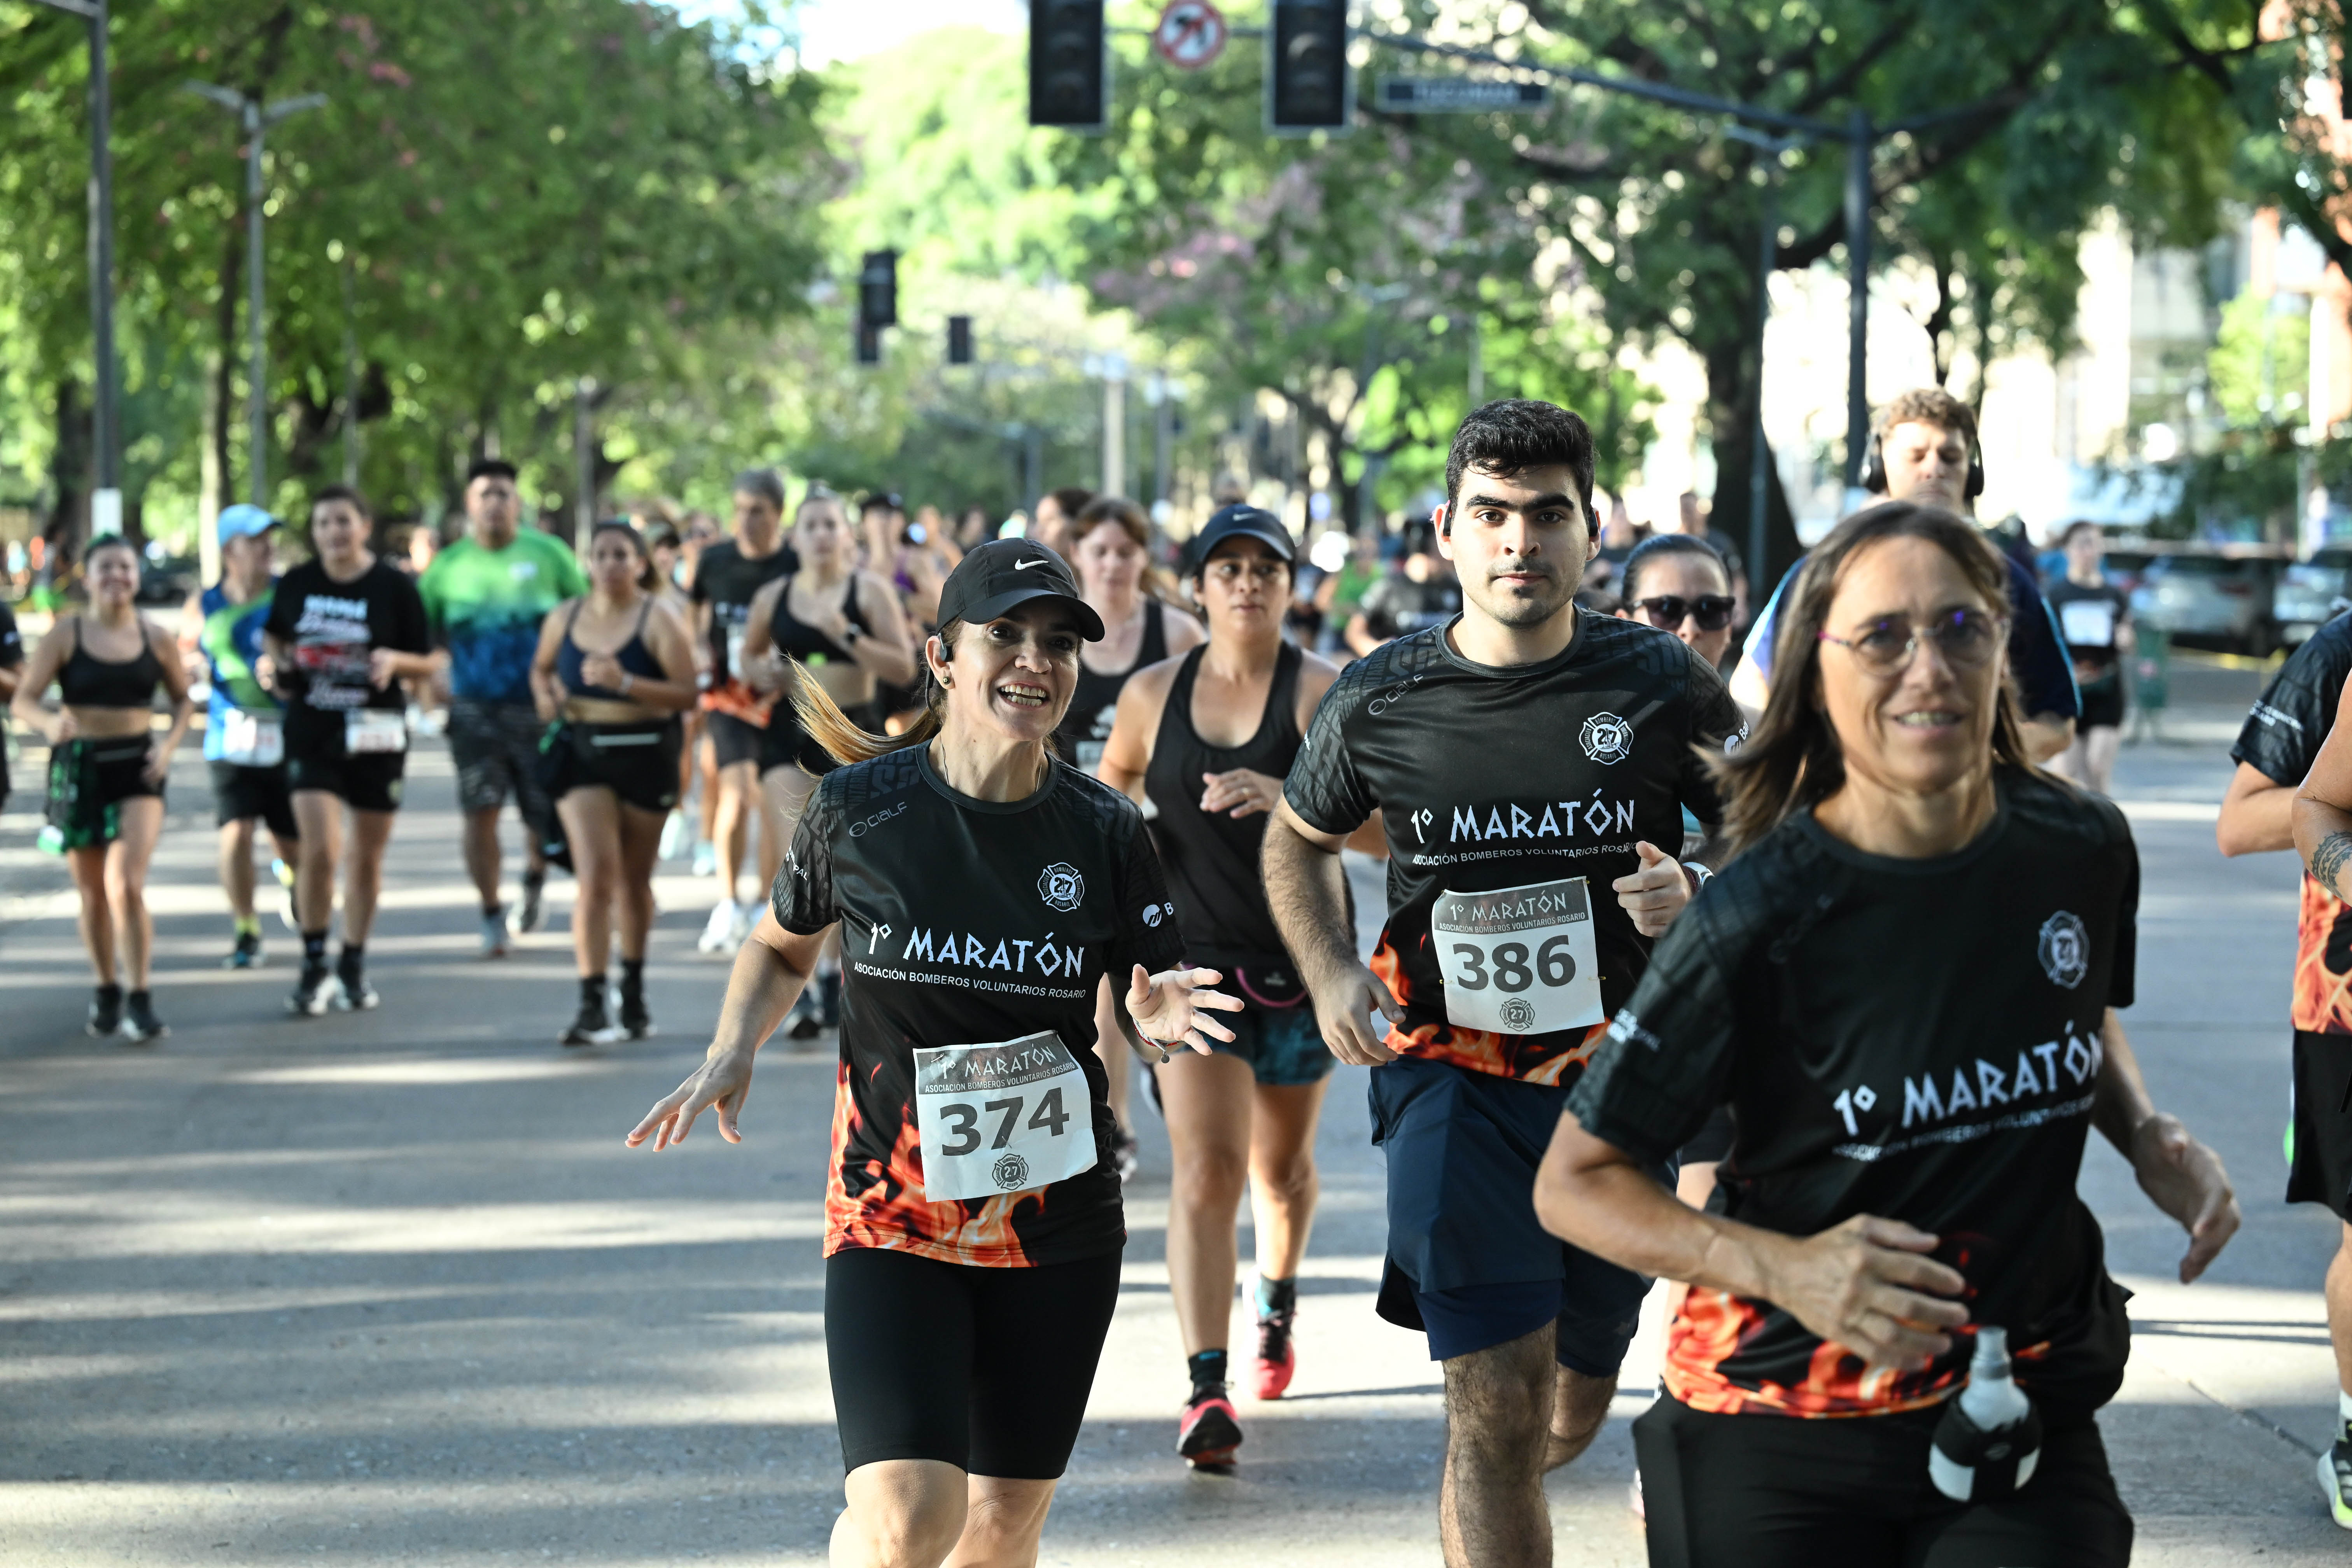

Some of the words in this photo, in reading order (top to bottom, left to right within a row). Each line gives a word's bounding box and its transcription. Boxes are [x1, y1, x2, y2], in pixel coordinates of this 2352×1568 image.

[1597, 728, 1617, 745] 27
[1450, 788, 1634, 843] MARATÓN
[1054, 867, 1073, 875] BOMBEROS
[1412, 853, 1458, 866] ASOCIACIÓN
[1460, 849, 1522, 861] BOMBEROS
[1526, 846, 1599, 858] VOLUNTARIOS
[1054, 877, 1073, 893] 27
[1472, 890, 1567, 921] MARATÓN
[1439, 923, 1474, 933] ASOCIACIÓN
[1475, 924, 1511, 933] BOMBEROS
[1512, 918, 1556, 930] VOLUNTARIOS
[1557, 912, 1586, 923] ROSARIO
[902, 926, 1085, 978] MARATÓN
[1452, 934, 1576, 993] 386
[854, 961, 906, 981] ASOCIACIÓN
[909, 972, 970, 987] BOMBEROS
[973, 979, 1046, 996] VOLUNTARIOS
[1048, 988, 1086, 999] ROSARIO
[1510, 1008, 1524, 1020] 27
[964, 1044, 1057, 1078] MARATÓN
[925, 1082, 966, 1093] ASOCIACIÓN
[967, 1079, 1005, 1090] BOMBEROS
[1007, 1069, 1051, 1086] VOLUNTARIOS
[1052, 1062, 1075, 1075] ROSARIO
[940, 1087, 1070, 1157] 374
[1004, 1166, 1018, 1179] 27
